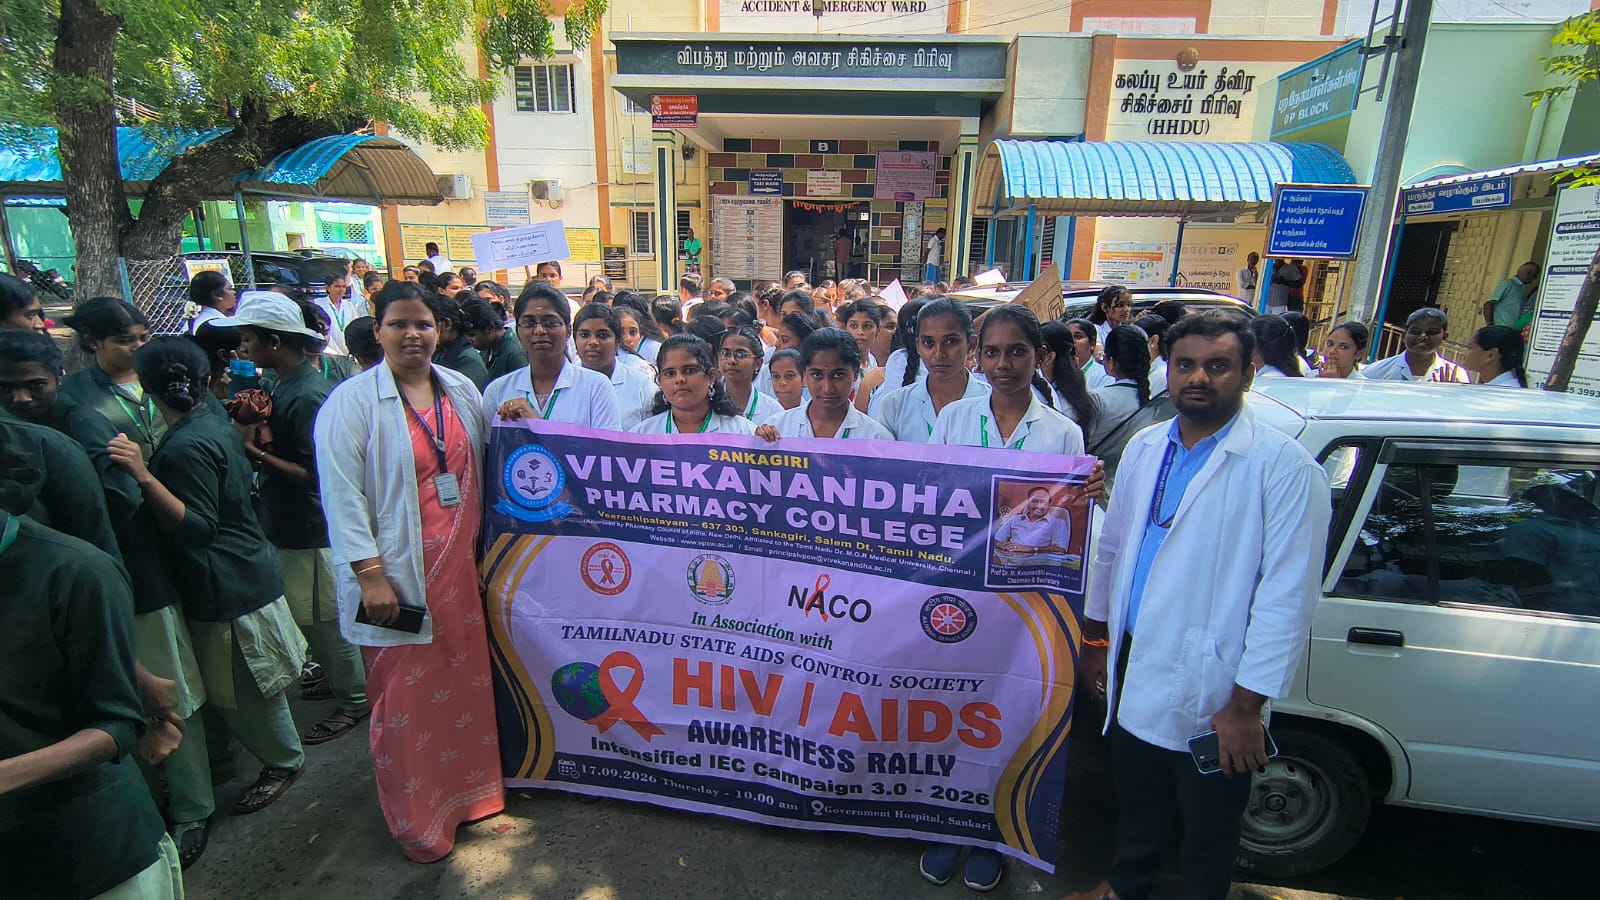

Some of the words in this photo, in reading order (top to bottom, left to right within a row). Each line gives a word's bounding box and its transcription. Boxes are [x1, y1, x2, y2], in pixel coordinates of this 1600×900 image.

[741, 0, 800, 12] ACCIDENT
[803, 1, 811, 12] &
[821, 1, 888, 13] MERGENCY
[892, 1, 926, 13] WARD
[677, 45, 727, 70] விபத்து
[734, 46, 785, 71] மற்றும்
[792, 51, 841, 70] அவசர
[847, 47, 907, 68] சிகிச்சை
[913, 47, 952, 71] பிரிவு
[1115, 69, 1160, 93] கலப்பு
[1167, 69, 1208, 90] உயர்
[1213, 67, 1256, 95] தீவிர
[1121, 92, 1193, 114] சிகிச்சைப்
[1200, 93, 1242, 119] பிரிவு
[1298, 99, 1331, 120] BLOCK
[1147, 118, 1210, 135] (HHDU)
[818, 142, 829, 152] B
[1408, 189, 1436, 202] மருந்து
[1439, 184, 1478, 198] வழங்கும்
[1481, 180, 1506, 192] இடம்
[709, 449, 808, 469] SANKAGIRI
[565, 454, 982, 519] VIVEKANANDHA
[585, 487, 773, 523] PHARMACY
[785, 507, 965, 549] COLLEGE
[598, 510, 689, 527] Veerachipalayam
[702, 521, 722, 531] 637
[725, 524, 748, 535] 303,
[752, 527, 811, 543] Sankagiri,
[814, 535, 852, 549] Salem
[878, 544, 914, 558] Tamil
[918, 550, 955, 564] Nadu.
[783, 540, 794, 548] the
[796, 542, 813, 550] Tamil
[815, 545, 833, 553] Nadu
[869, 554, 897, 563] Medical
[788, 585, 872, 623] NACO
[691, 611, 707, 625] In
[711, 613, 796, 643] Association
[799, 628, 833, 650] with
[560, 625, 675, 647] TAMILNADU
[680, 634, 736, 655] STATE
[739, 645, 785, 664] AIDS
[791, 655, 883, 687] CONTROL
[889, 676, 985, 693] SOCIETY
[672, 657, 785, 718] HIV
[798, 682, 815, 727] /
[828, 692, 1003, 749] AIDS
[687, 719, 856, 774] AWARENESS
[867, 751, 956, 777] RALLY
[591, 736, 702, 767] Intensified
[709, 754, 747, 774] IEC
[753, 762, 864, 796] Campaign
[871, 781, 908, 796] 3.0
[930, 787, 990, 807] 2026
[581, 764, 658, 785] 17.09.2026
[660, 777, 720, 798] Thursday
[736, 789, 775, 807] 10.00
[778, 801, 799, 810] am
[823, 804, 893, 820] Government
[896, 810, 945, 826] Hospital,
[948, 818, 992, 831] Sankari
